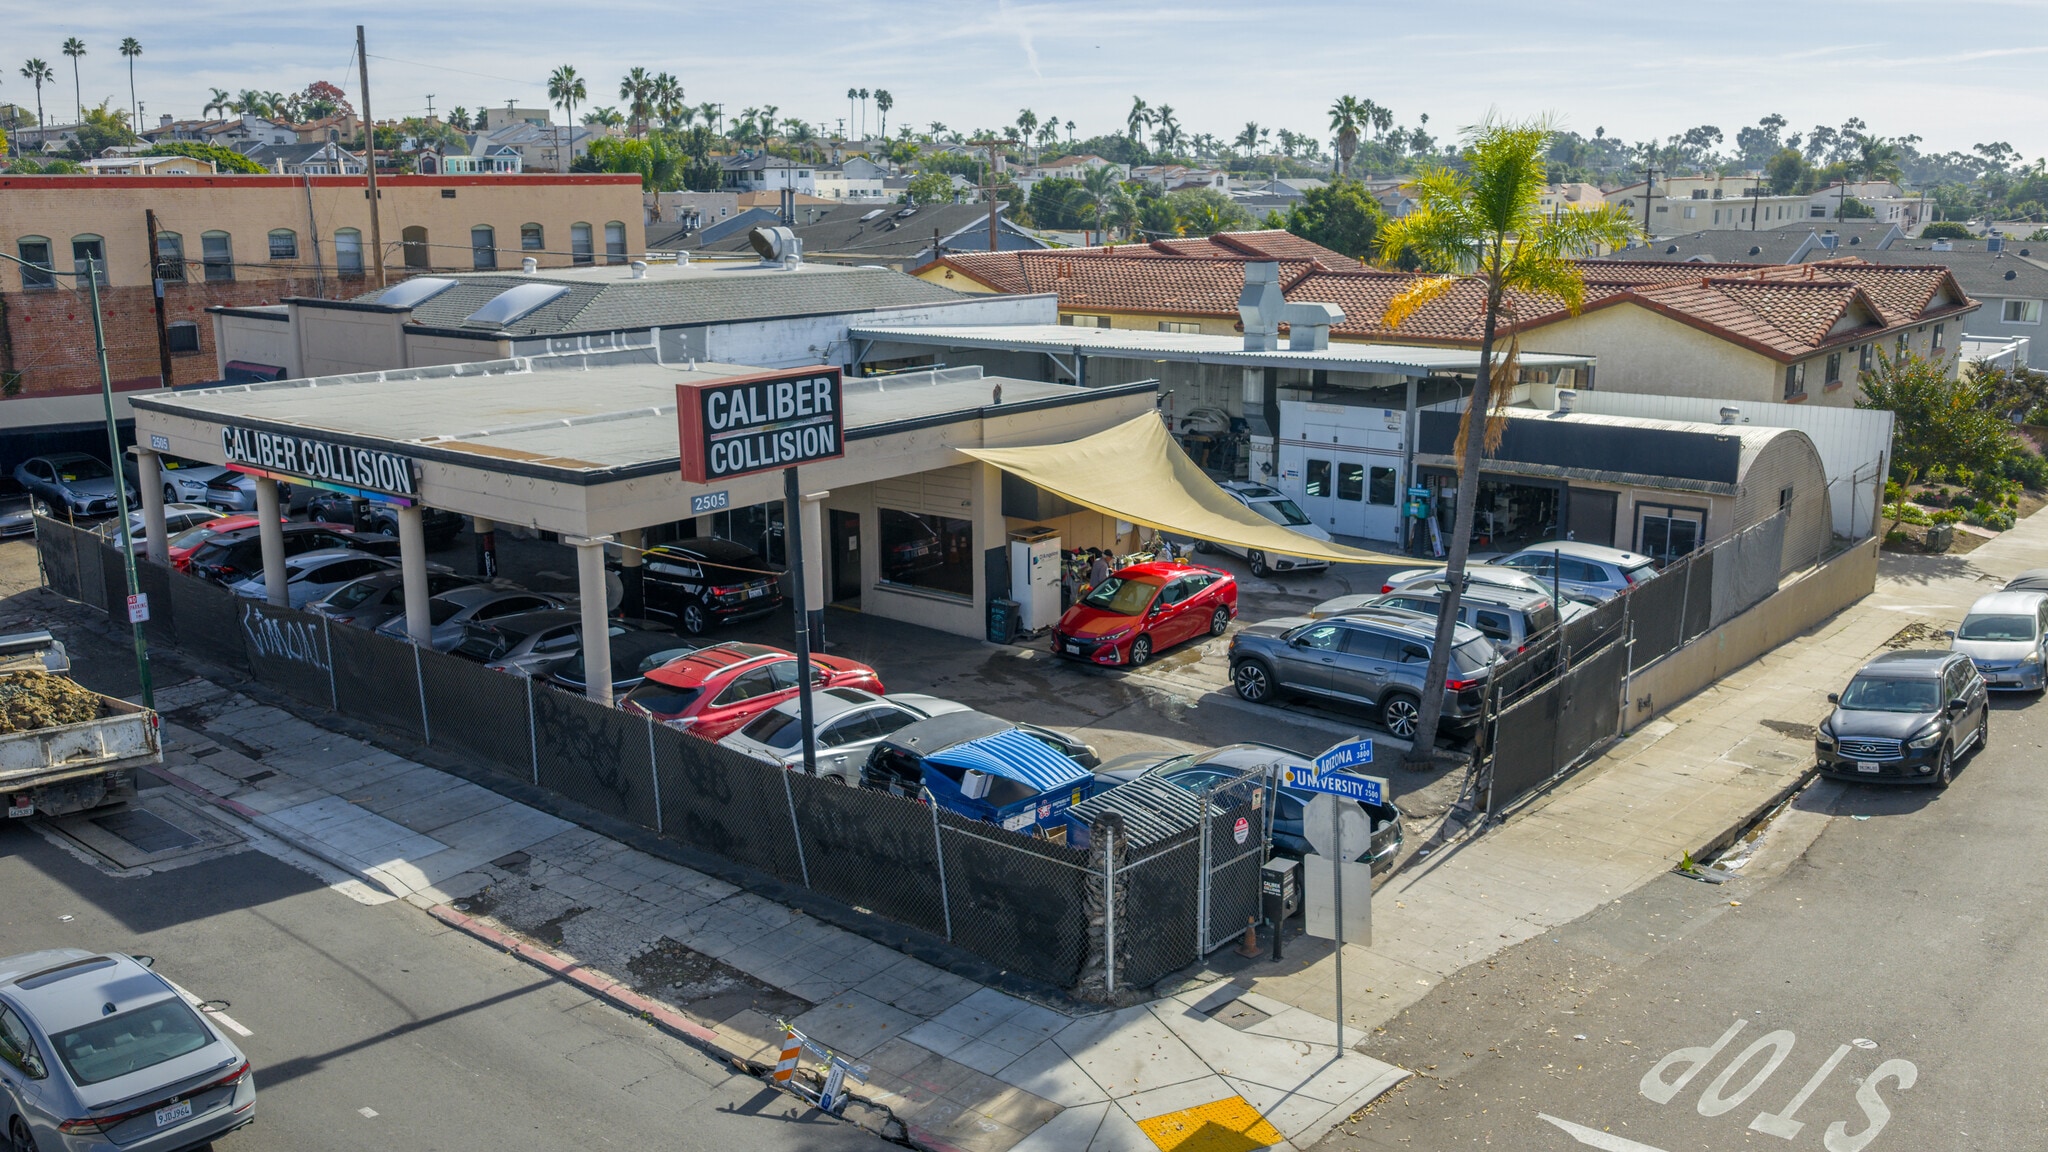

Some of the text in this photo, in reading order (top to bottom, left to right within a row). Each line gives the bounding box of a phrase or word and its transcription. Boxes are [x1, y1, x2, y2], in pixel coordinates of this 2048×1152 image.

[707, 377, 833, 430] CALIBER
[152, 436, 168, 450] 2505
[710, 424, 836, 474] COLLISION
[221, 426, 412, 494] CALIBER COLLISION
[695, 493, 725, 511] 2505
[129, 602, 148, 610] PARKING
[1356, 750, 1370, 759] 3800
[1359, 742, 1367, 751] ST
[1320, 749, 1353, 775] ARIZONA
[1365, 789, 1379, 799] 2500
[1367, 782, 1376, 790] AV
[1639, 1018, 1918, 1152] STOP
